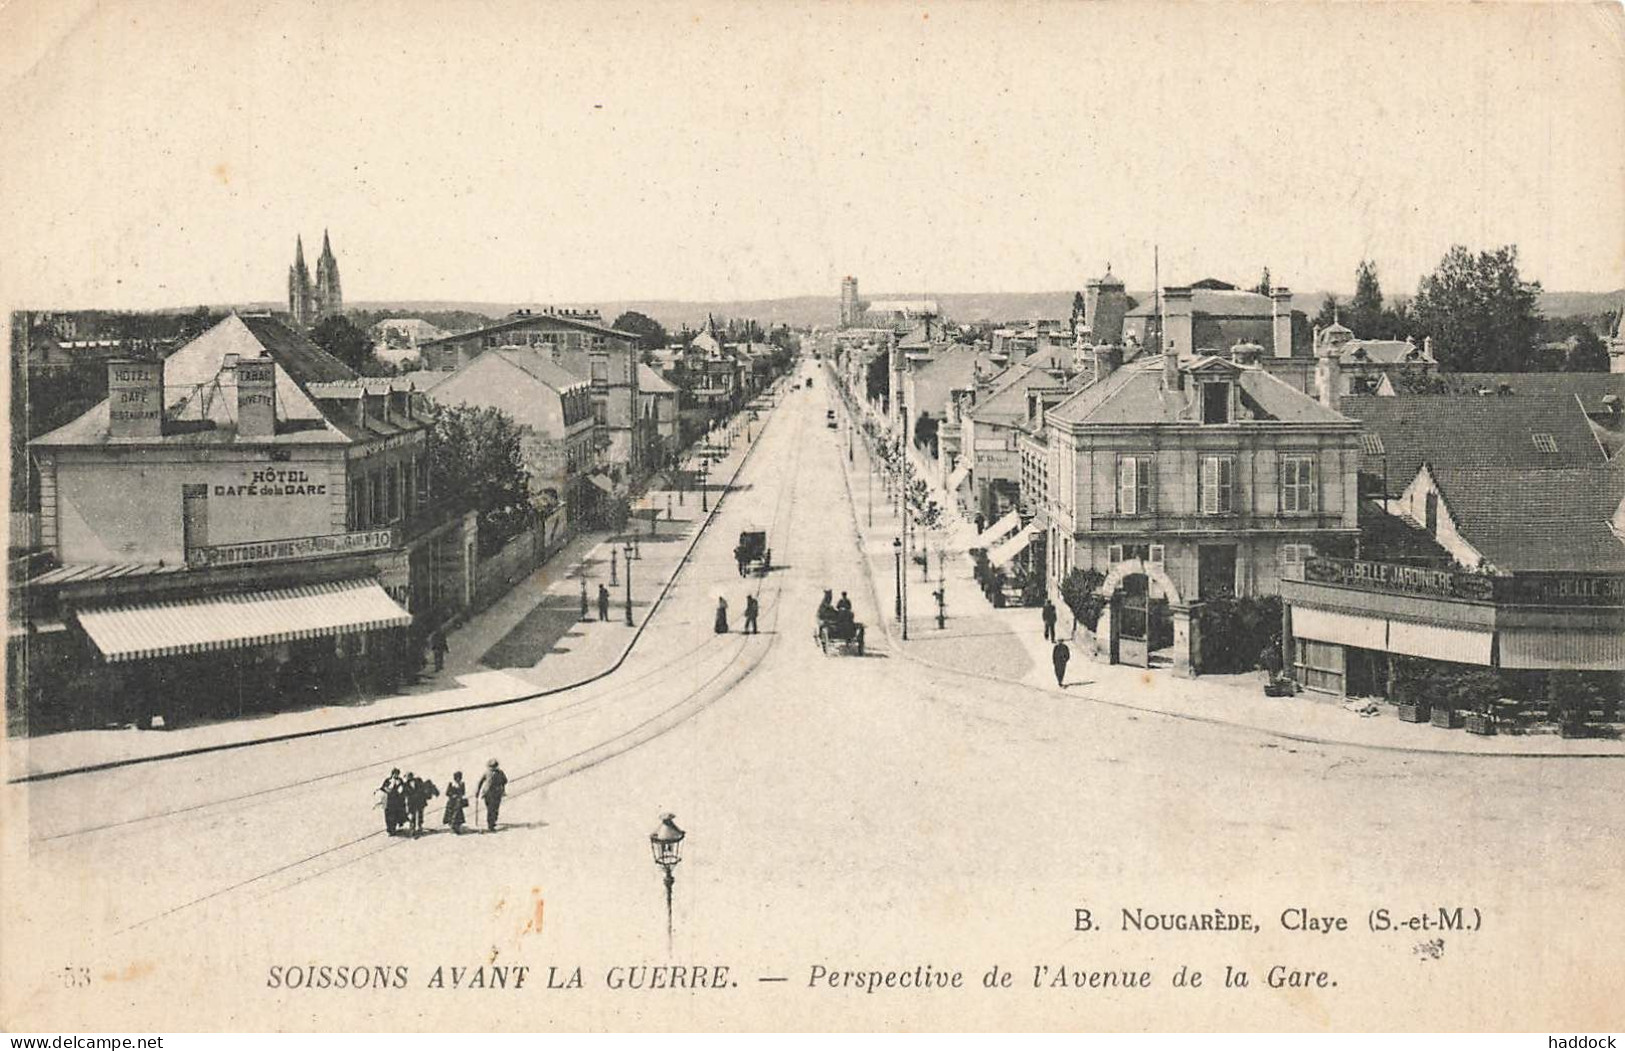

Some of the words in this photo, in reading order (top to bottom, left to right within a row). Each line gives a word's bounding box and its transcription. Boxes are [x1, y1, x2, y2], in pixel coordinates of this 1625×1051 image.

[252, 466, 309, 483] HÔTEL
[214, 482, 258, 496] CAFÉ
[284, 484, 326, 495] GARE
[1352, 562, 1388, 583] BELLE
[1074, 908, 1099, 931] B.
[1280, 908, 1348, 934] Claye
[1368, 907, 1482, 932] (S.-et-M.)
[267, 966, 408, 989] SOISSONS
[427, 966, 530, 989] AVANT
[546, 966, 583, 989] LA
[606, 966, 738, 989] GUERRE.
[808, 965, 963, 994] Perspective
[982, 965, 1013, 988] de
[1172, 965, 1202, 988] de
[1225, 965, 1249, 988] la
[1267, 965, 1338, 989] Gare.
